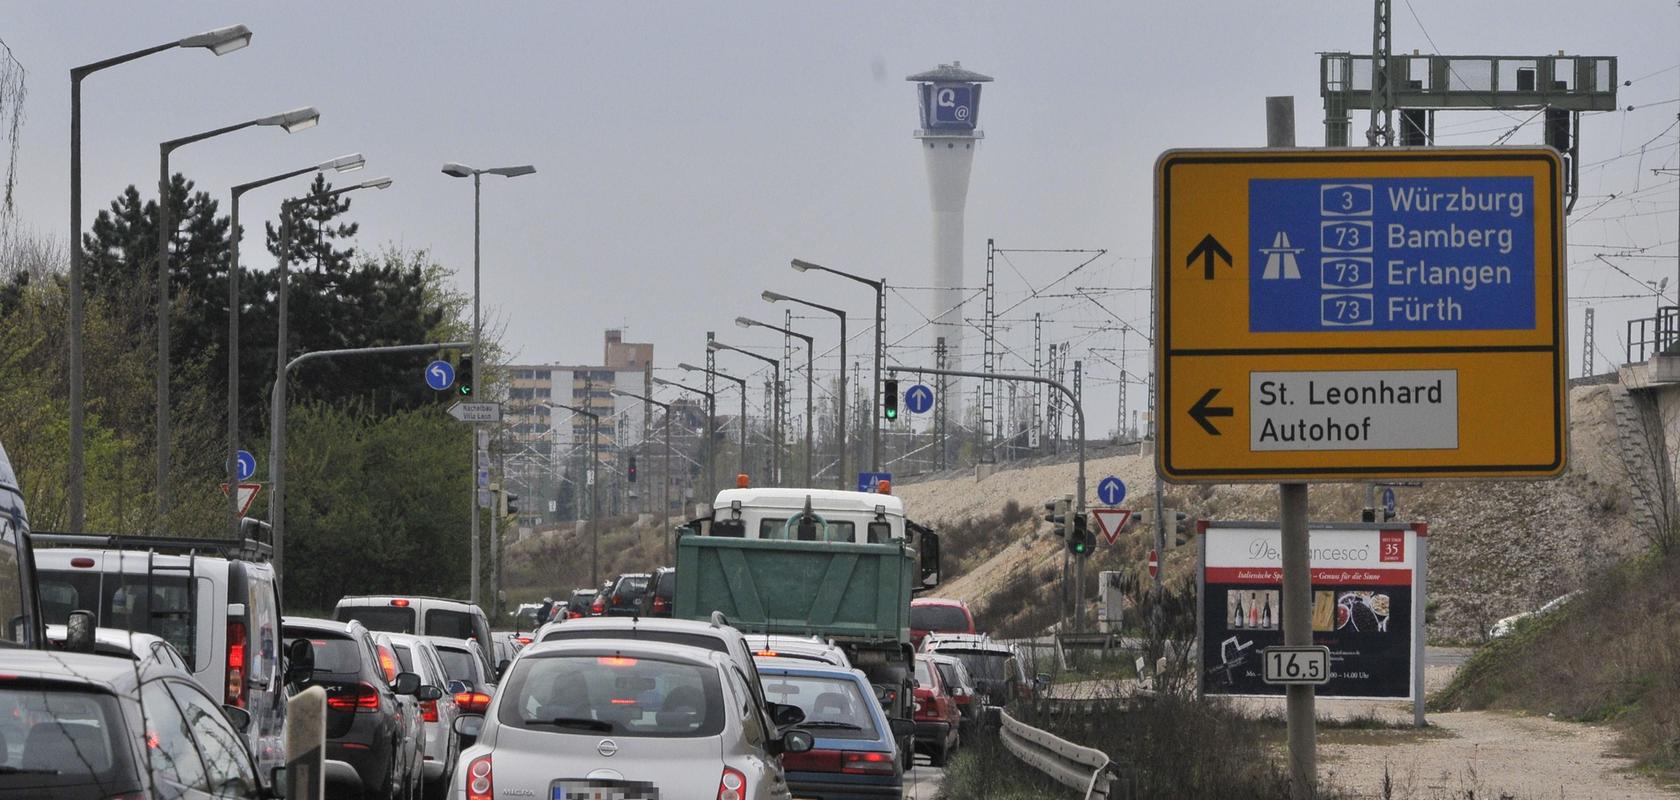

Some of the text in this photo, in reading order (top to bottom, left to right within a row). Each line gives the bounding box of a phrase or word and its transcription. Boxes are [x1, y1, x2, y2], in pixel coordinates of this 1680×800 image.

[937, 88, 955, 108] Q
[1341, 186, 1523, 217] 3 Würzburg
[1335, 223, 1513, 254] 73 Bamberg
[1335, 260, 1511, 291] 73 Erlangen
[1335, 297, 1462, 321] 73 Fürth
[1259, 379, 1442, 405] St. Leonhard
[1259, 416, 1371, 442] Autohof
[1385, 543, 1398, 555] 35
